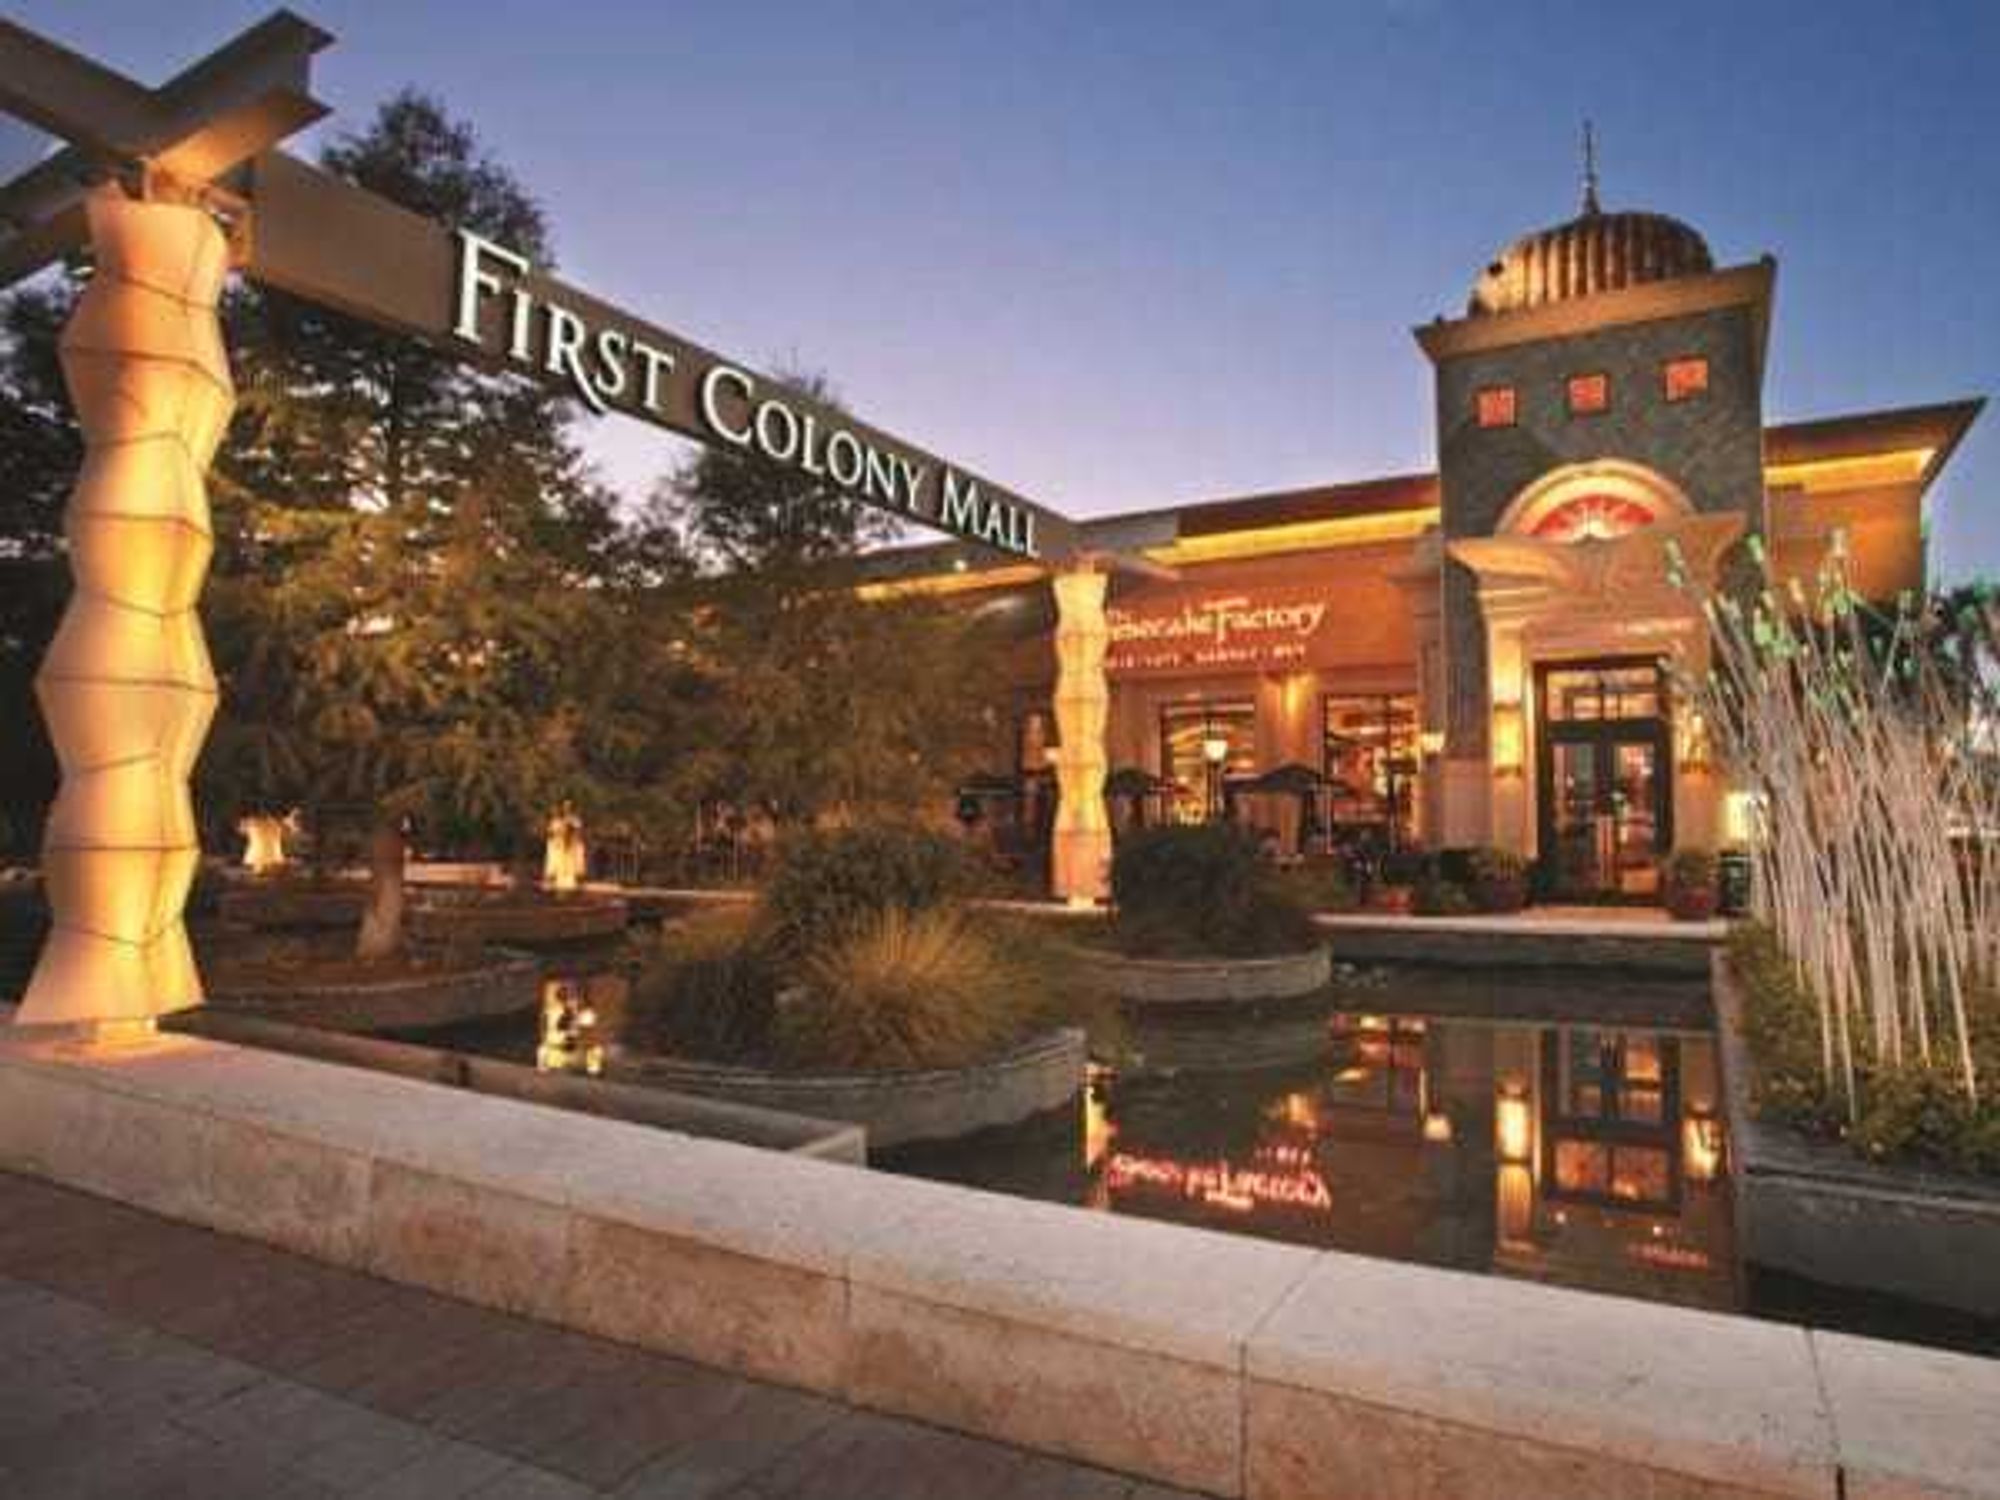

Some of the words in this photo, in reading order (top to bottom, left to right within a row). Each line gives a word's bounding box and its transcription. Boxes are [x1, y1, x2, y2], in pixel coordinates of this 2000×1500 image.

[452, 229, 674, 411] FIRST
[703, 366, 925, 508] COLONY
[940, 473, 1039, 557] MALL
[1202, 597, 1325, 642] Factory
